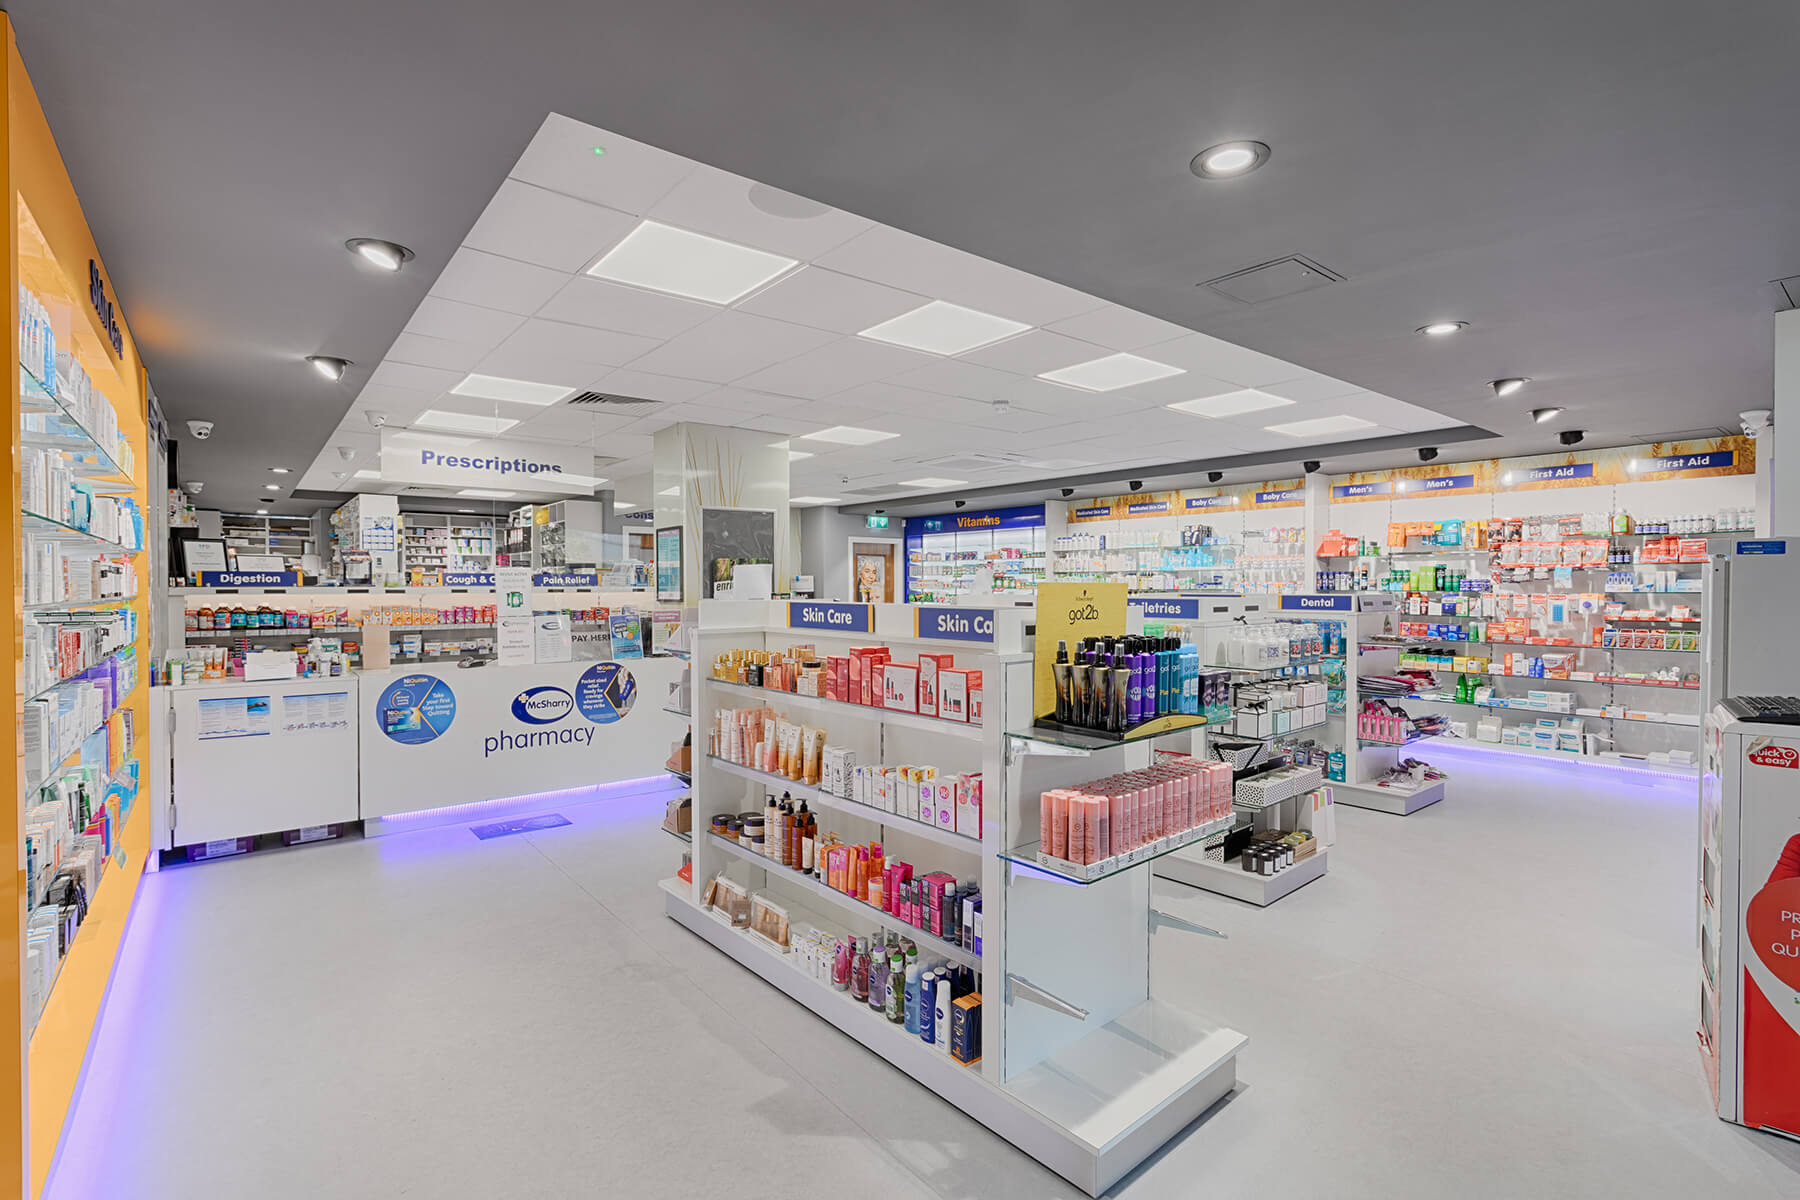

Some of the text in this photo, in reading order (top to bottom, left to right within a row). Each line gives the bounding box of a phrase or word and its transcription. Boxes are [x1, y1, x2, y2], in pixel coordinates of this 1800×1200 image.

[421, 449, 563, 475] Prescriptions
[1656, 456, 1710, 469] First Aid
[1529, 467, 1574, 479] First Aid
[1426, 479, 1453, 489] Men's
[1349, 486, 1373, 495] Men's
[1262, 493, 1280, 501] Baby
[1191, 499, 1207, 507] Baby
[957, 515, 1001, 528] Vitamins
[220, 574, 281, 585] Digestion
[446, 575, 477, 587] Cough
[479, 575, 488, 585] &
[543, 576, 590, 585] Pain Relief
[1301, 597, 1335, 608] Dental
[803, 607, 853, 625] Skin Care
[1068, 604, 1099, 625] got2b
[937, 613, 993, 634] Skin Ca
[571, 633, 588, 643] PAY
[527, 700, 571, 709] McSharry
[484, 726, 596, 758] pharmacy
[1765, 757, 1791, 767] easy
[1771, 942, 1799, 958] QU
